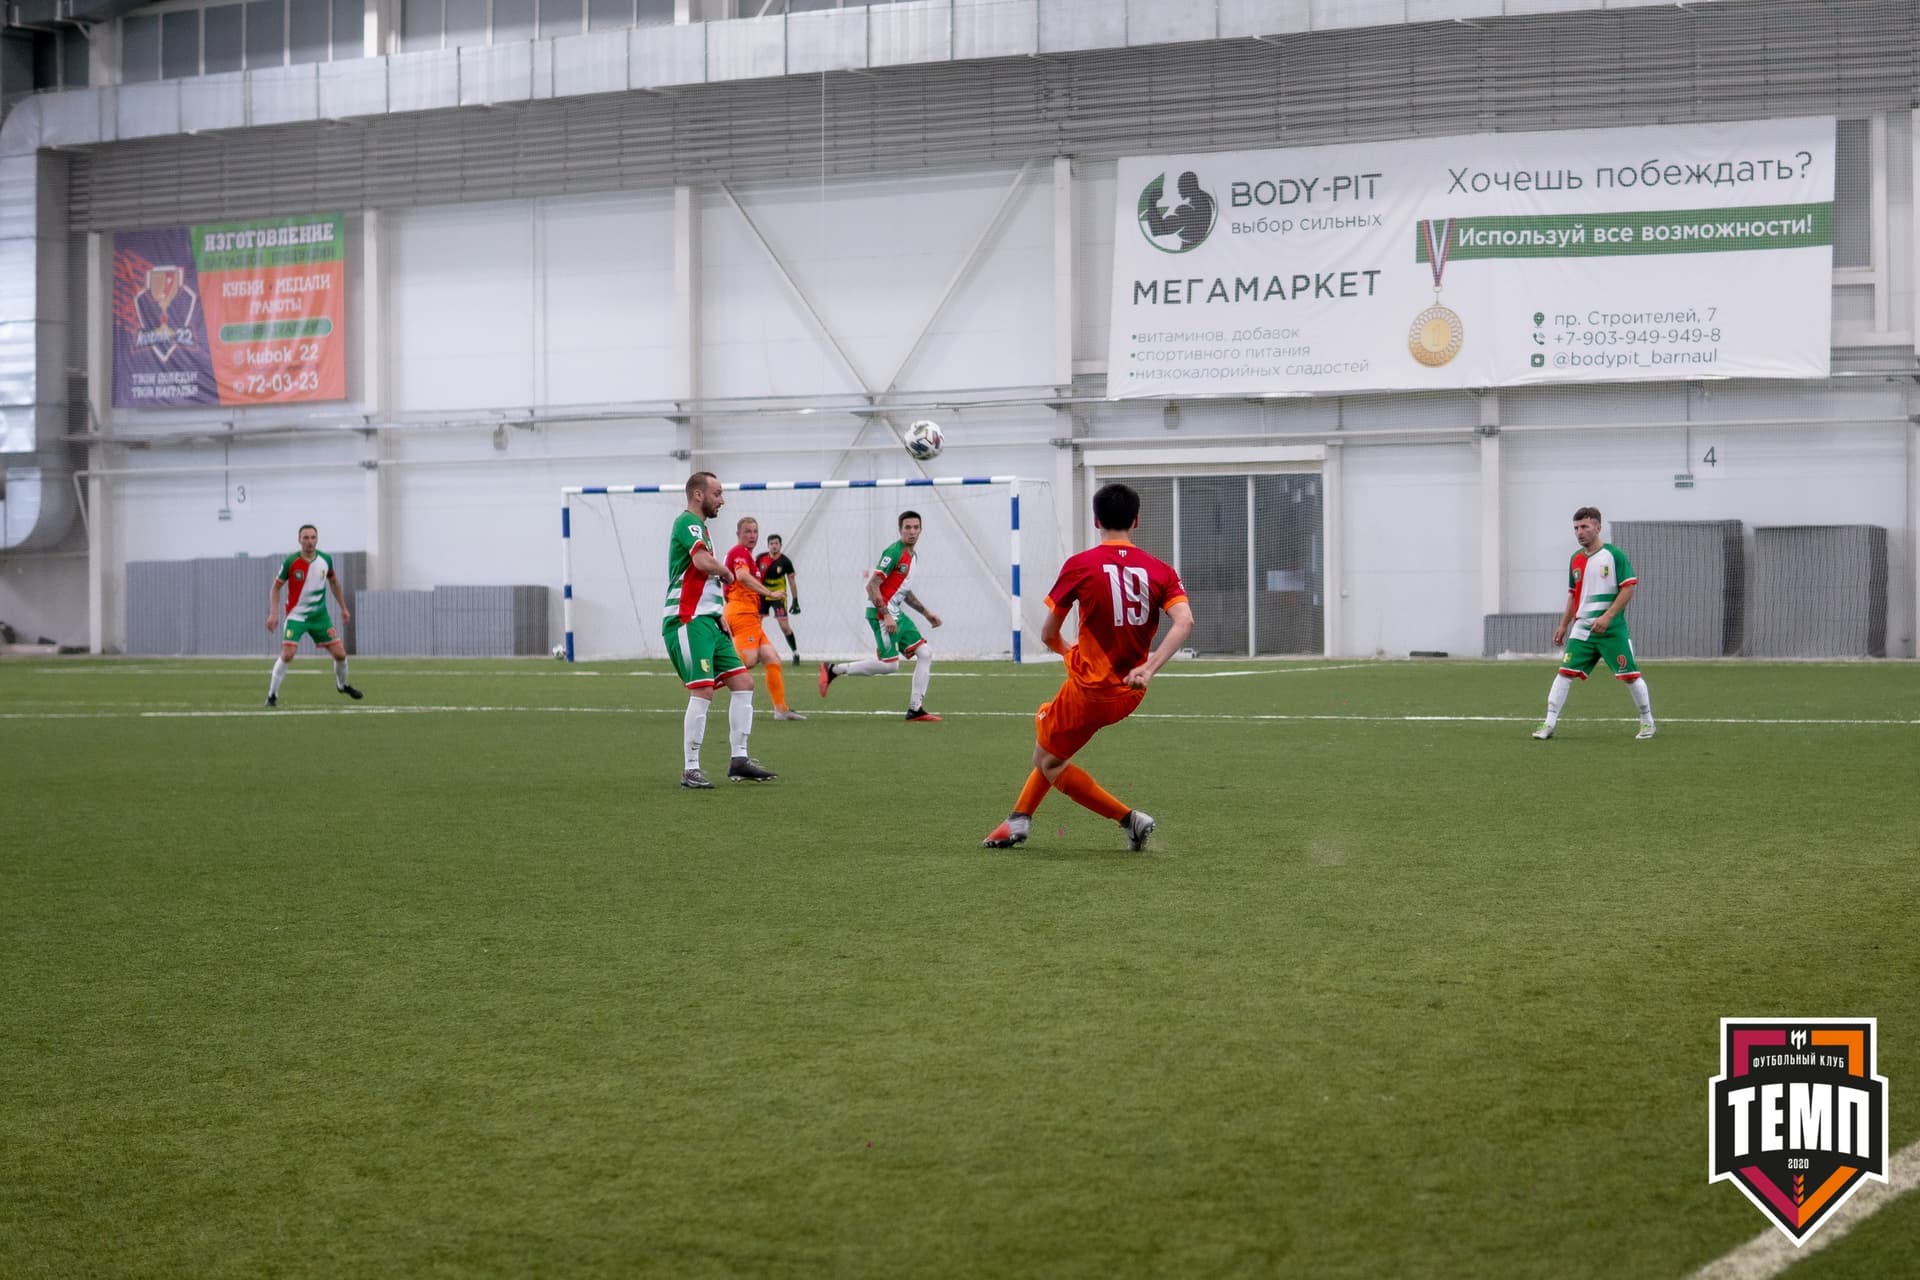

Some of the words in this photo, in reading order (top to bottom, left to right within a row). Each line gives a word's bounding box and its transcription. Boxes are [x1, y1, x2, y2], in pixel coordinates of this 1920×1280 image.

[1447, 166, 1583, 194] Хочешь
[1596, 150, 1813, 190] побеждать?
[1231, 173, 1382, 207] BODY-PIT
[1231, 217, 1293, 235] выбор
[1300, 214, 1382, 231] сильных
[1458, 226, 1586, 250] Используй
[1594, 228, 1633, 243] все
[1641, 213, 1813, 241] возможности!
[204, 223, 334, 252] ИЗГОТОВЛЕНИЕ
[223, 280, 264, 297] КУБКИ
[275, 274, 331, 293] МЕДАЛИ
[1133, 270, 1381, 305] МЕГАМАРКЕТ
[1554, 313, 1581, 328] пр.
[1587, 309, 1700, 327] Строителей,
[1707, 307, 1717, 322] 7
[175, 328, 193, 345] 22
[1232, 327, 1300, 342] добавок
[1554, 328, 1721, 346] +7-903-949-949-8
[1136, 349, 1240, 363] спортивного
[1245, 345, 1311, 359] питания
[1553, 348, 1718, 369] @bodypit_barnaul
[1135, 364, 1280, 380] низкокалорийных
[1285, 360, 1369, 376] сладостей
[247, 371, 319, 393] 72-03-23
[1703, 446, 1717, 468] 4
[237, 485, 246, 504] 3
[1103, 564, 1150, 626] 19
